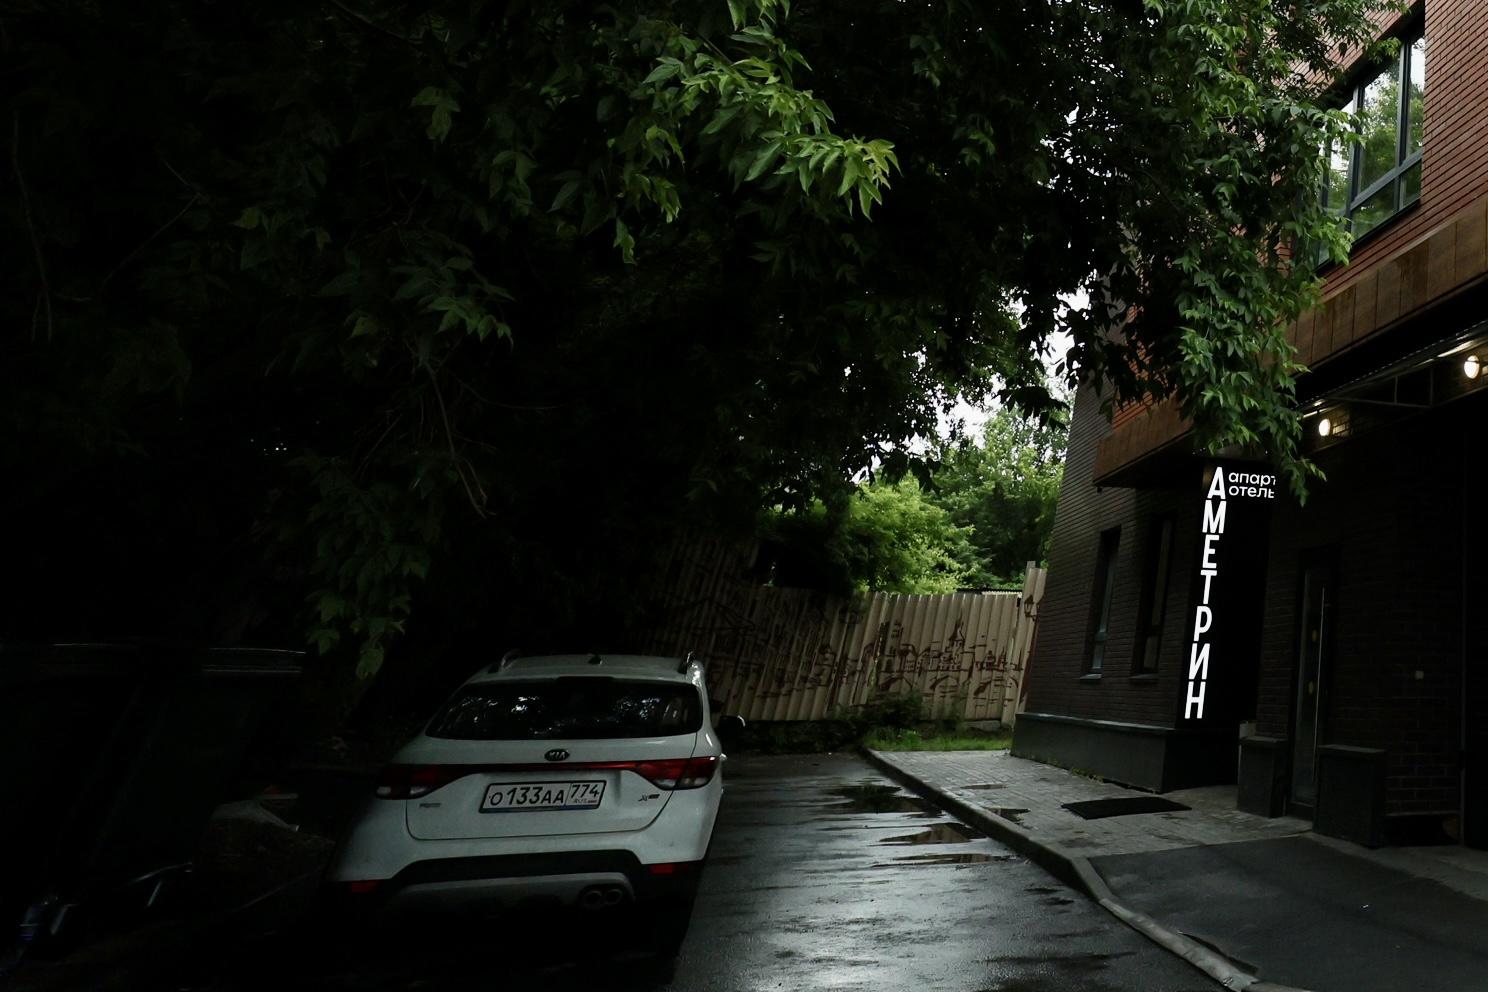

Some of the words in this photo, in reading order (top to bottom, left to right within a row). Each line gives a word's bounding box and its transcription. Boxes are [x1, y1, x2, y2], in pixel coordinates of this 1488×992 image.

[1228, 472, 1276, 487] апарт
[1228, 485, 1275, 499] отель
[1184, 466, 1227, 720] АМЕТРИН
